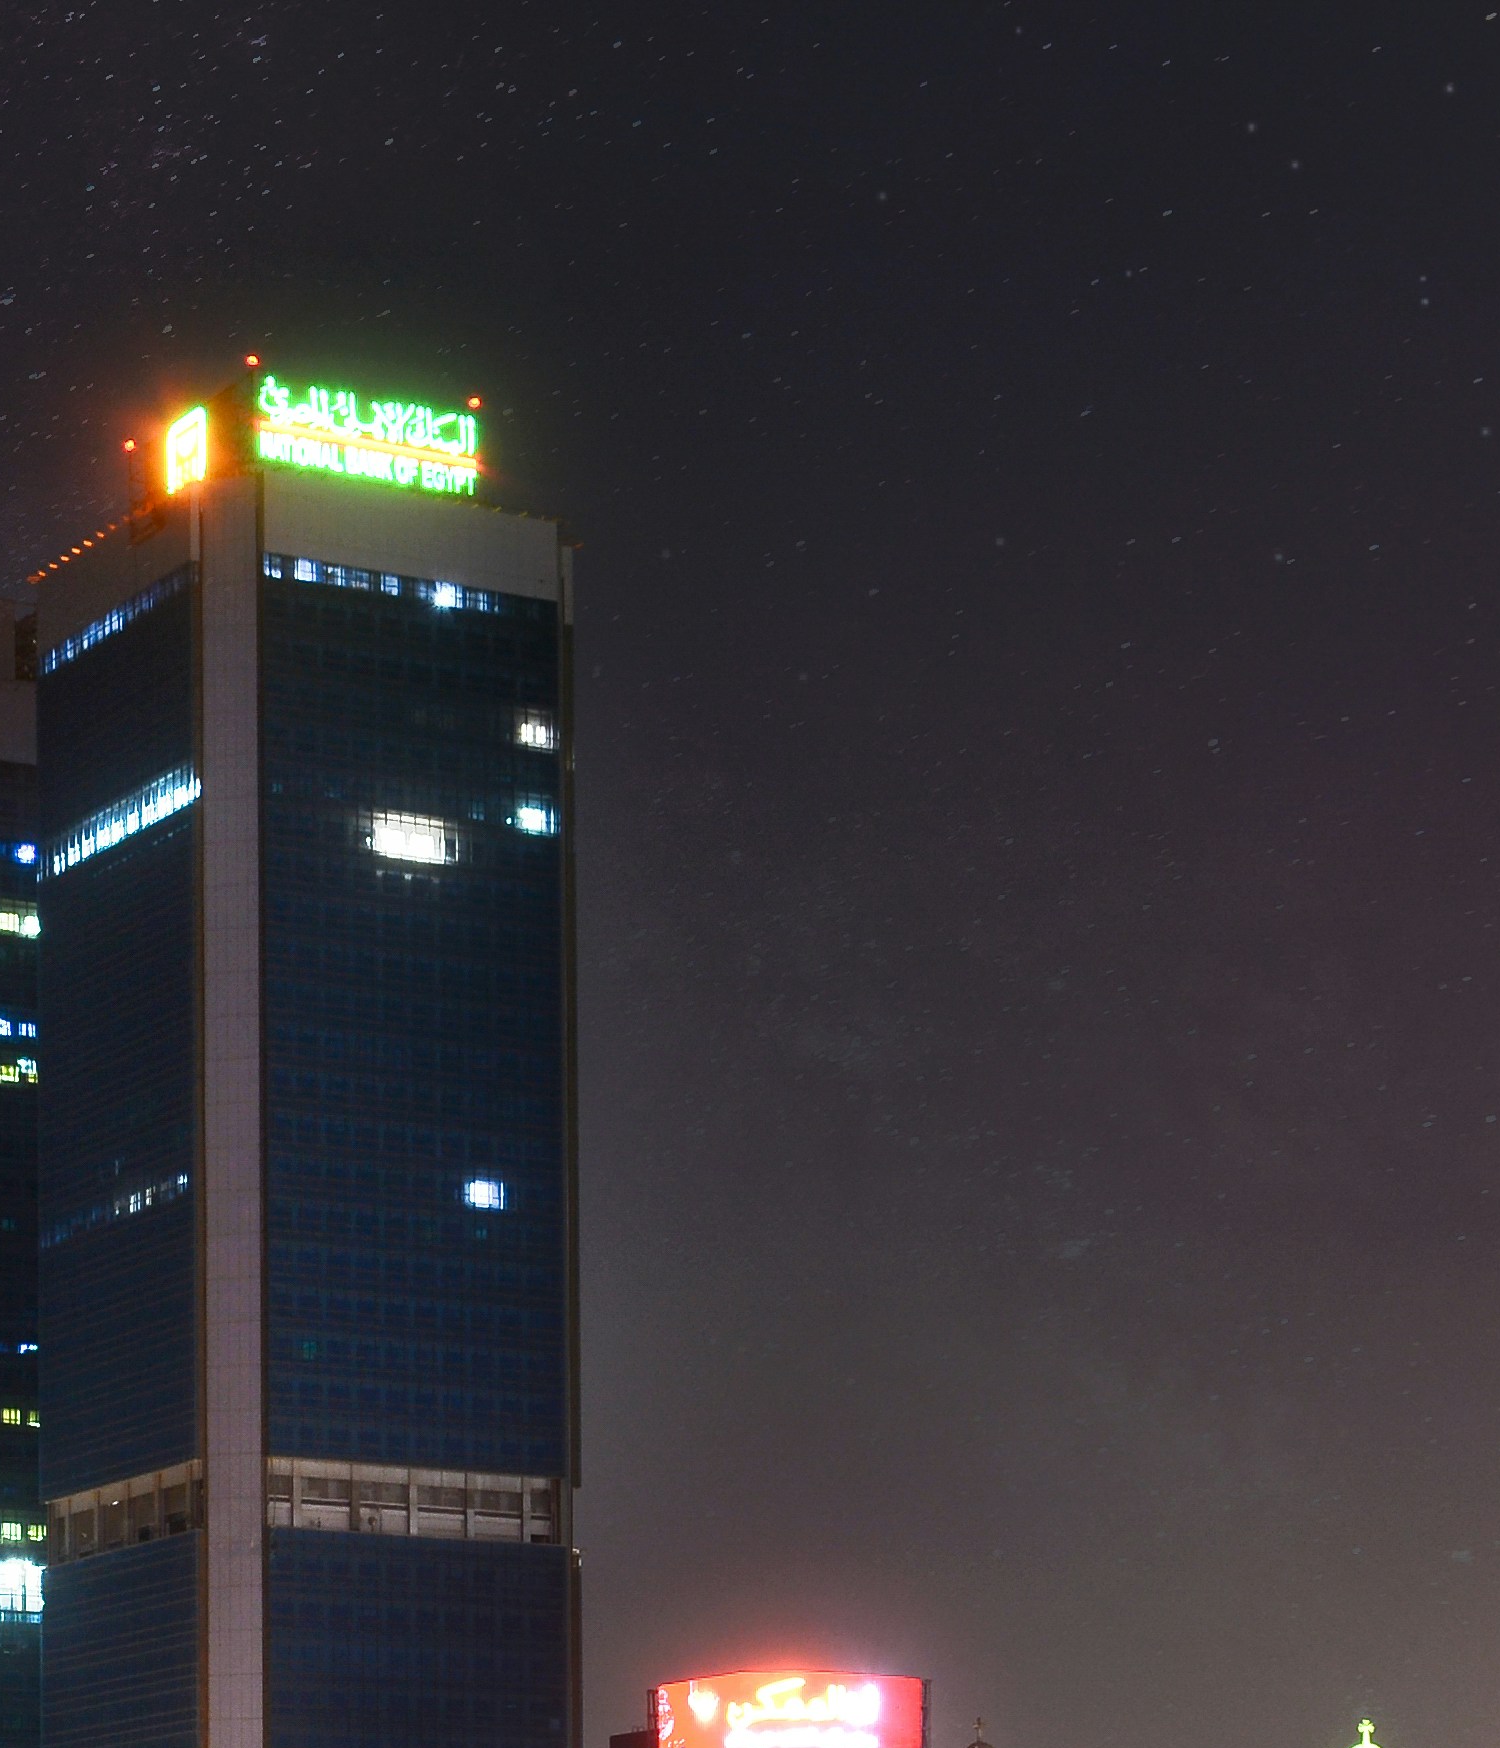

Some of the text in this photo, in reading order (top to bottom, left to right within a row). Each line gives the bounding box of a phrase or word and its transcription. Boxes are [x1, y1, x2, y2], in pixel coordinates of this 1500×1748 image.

[259, 429, 478, 496] NATIONAL BANK OF EGYPT
